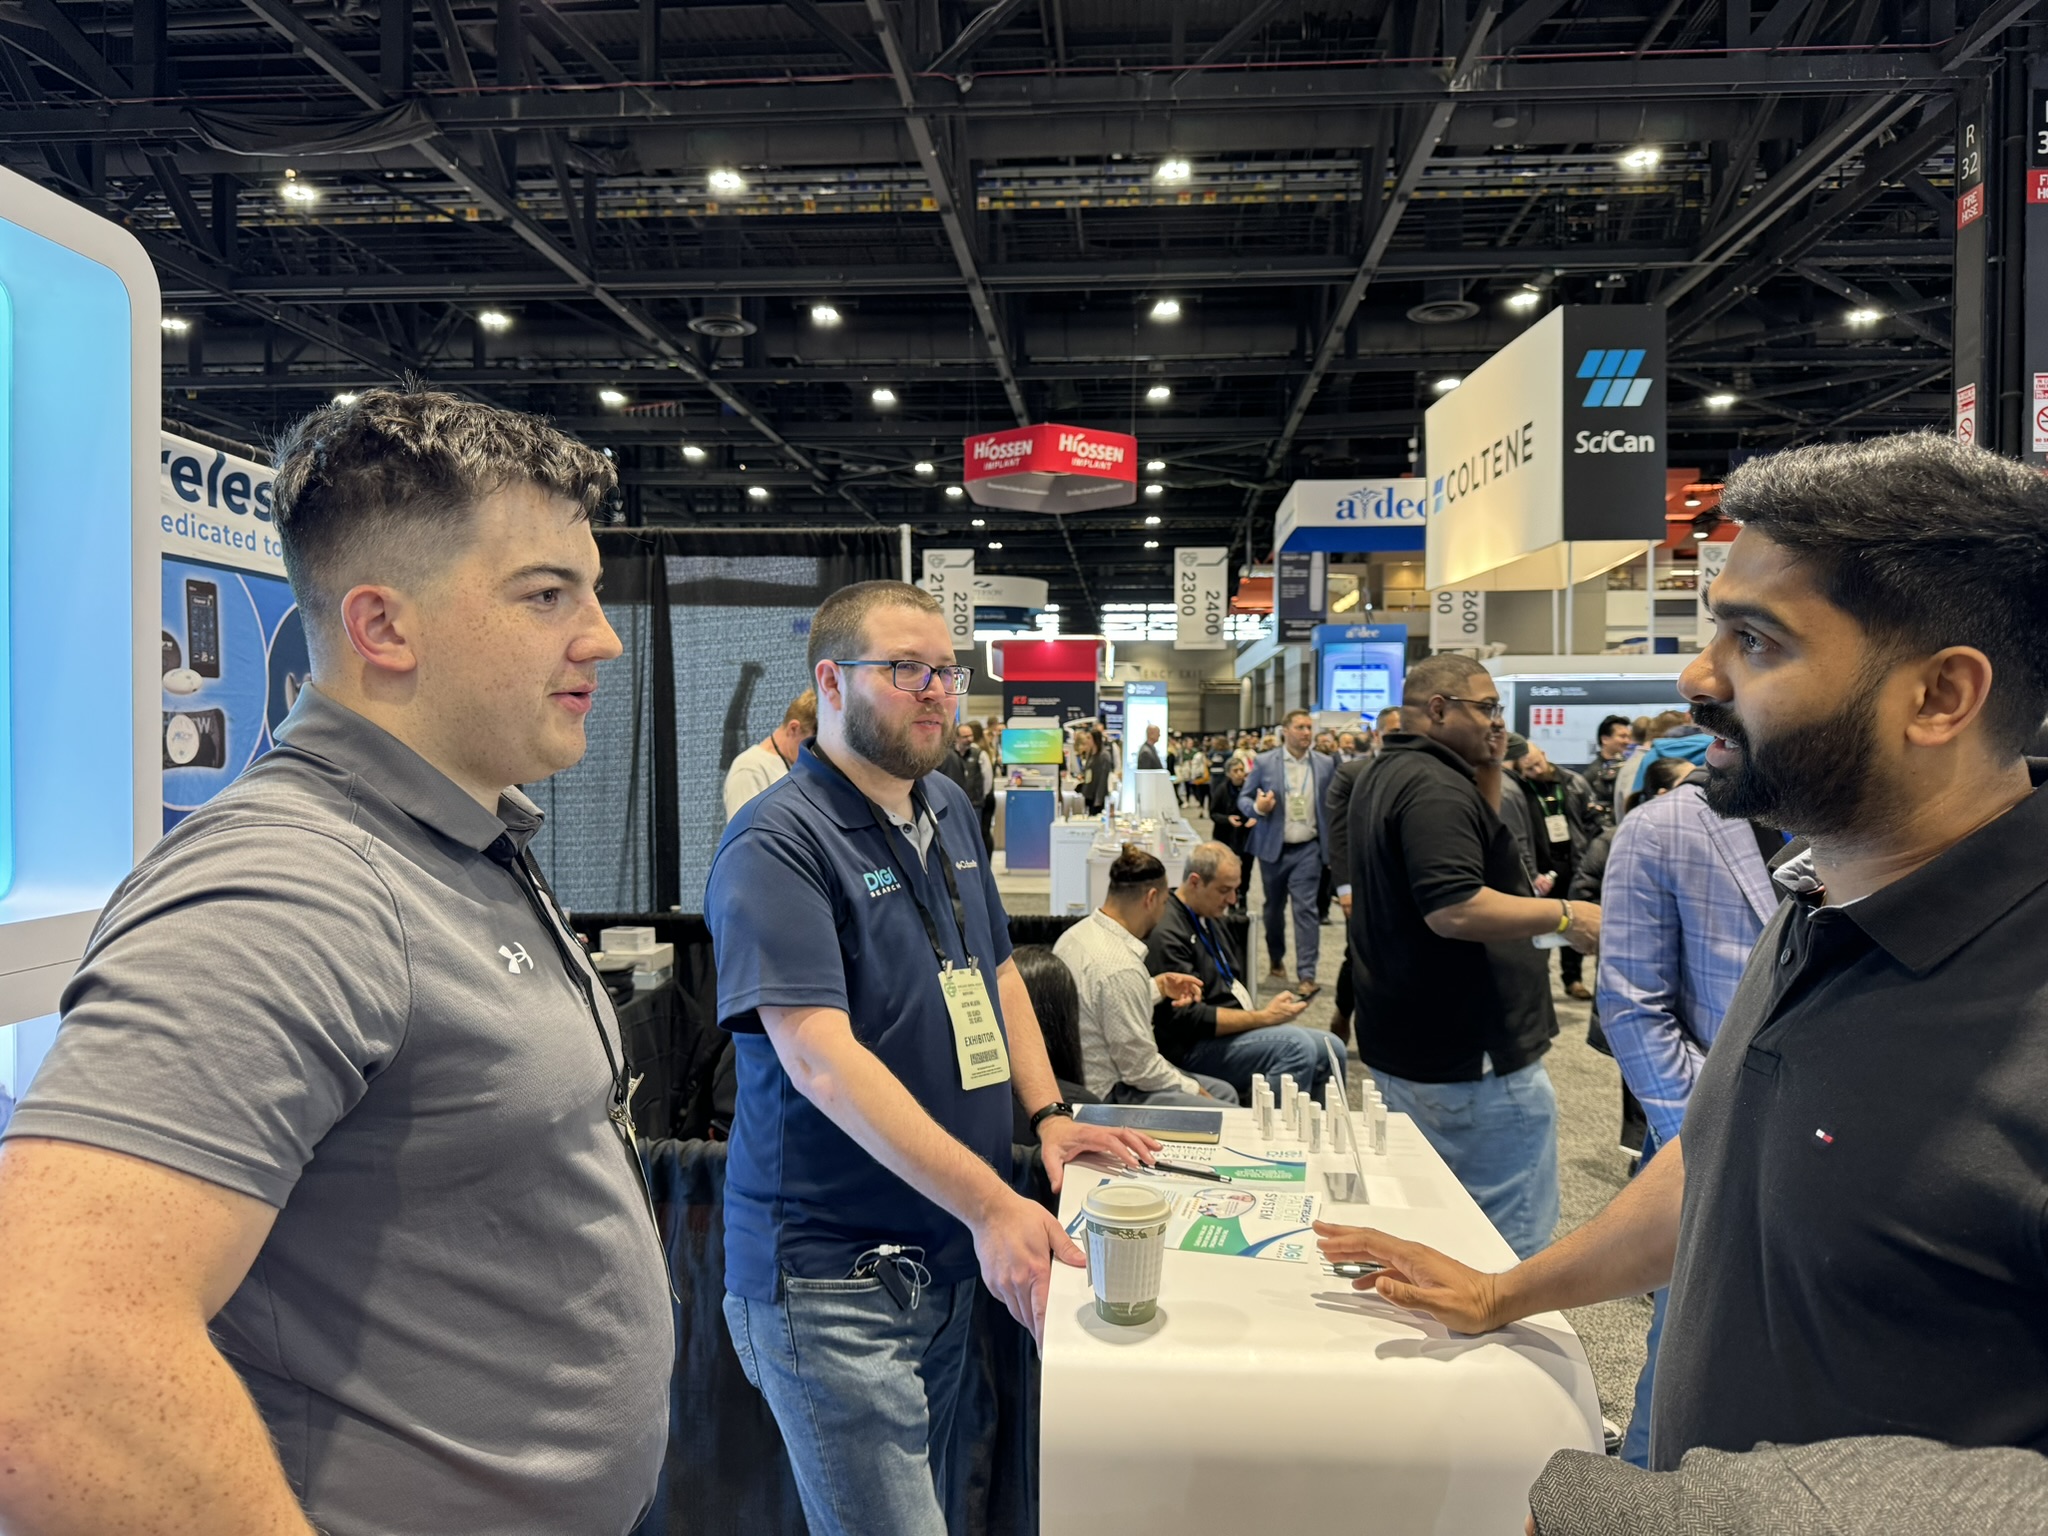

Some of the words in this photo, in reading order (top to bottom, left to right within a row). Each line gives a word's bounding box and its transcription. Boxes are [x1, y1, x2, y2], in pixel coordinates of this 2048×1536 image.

[1966, 124, 1975, 148] R
[1961, 152, 1978, 180] 32
[1963, 191, 1978, 210] FIRE
[1961, 203, 1978, 223] HOSE
[1573, 430, 1655, 454] SciCan
[983, 457, 1021, 471] IMPLANT
[1071, 457, 1113, 471] IMPLANT
[1447, 421, 1534, 504] COLTENE
[264, 535, 282, 558] to
[1181, 572, 1196, 617] 2300
[953, 592, 968, 636] 2200
[1205, 591, 1220, 636] 2400
[1462, 591, 1478, 634] 2600
[863, 866, 898, 891] DIGI
[870, 883, 902, 898] SEARCH
[964, 1031, 996, 1047] EXHIBITOR
[1260, 1193, 1278, 1221] SYSTEM
[1282, 1243, 1303, 1260] DIGI
